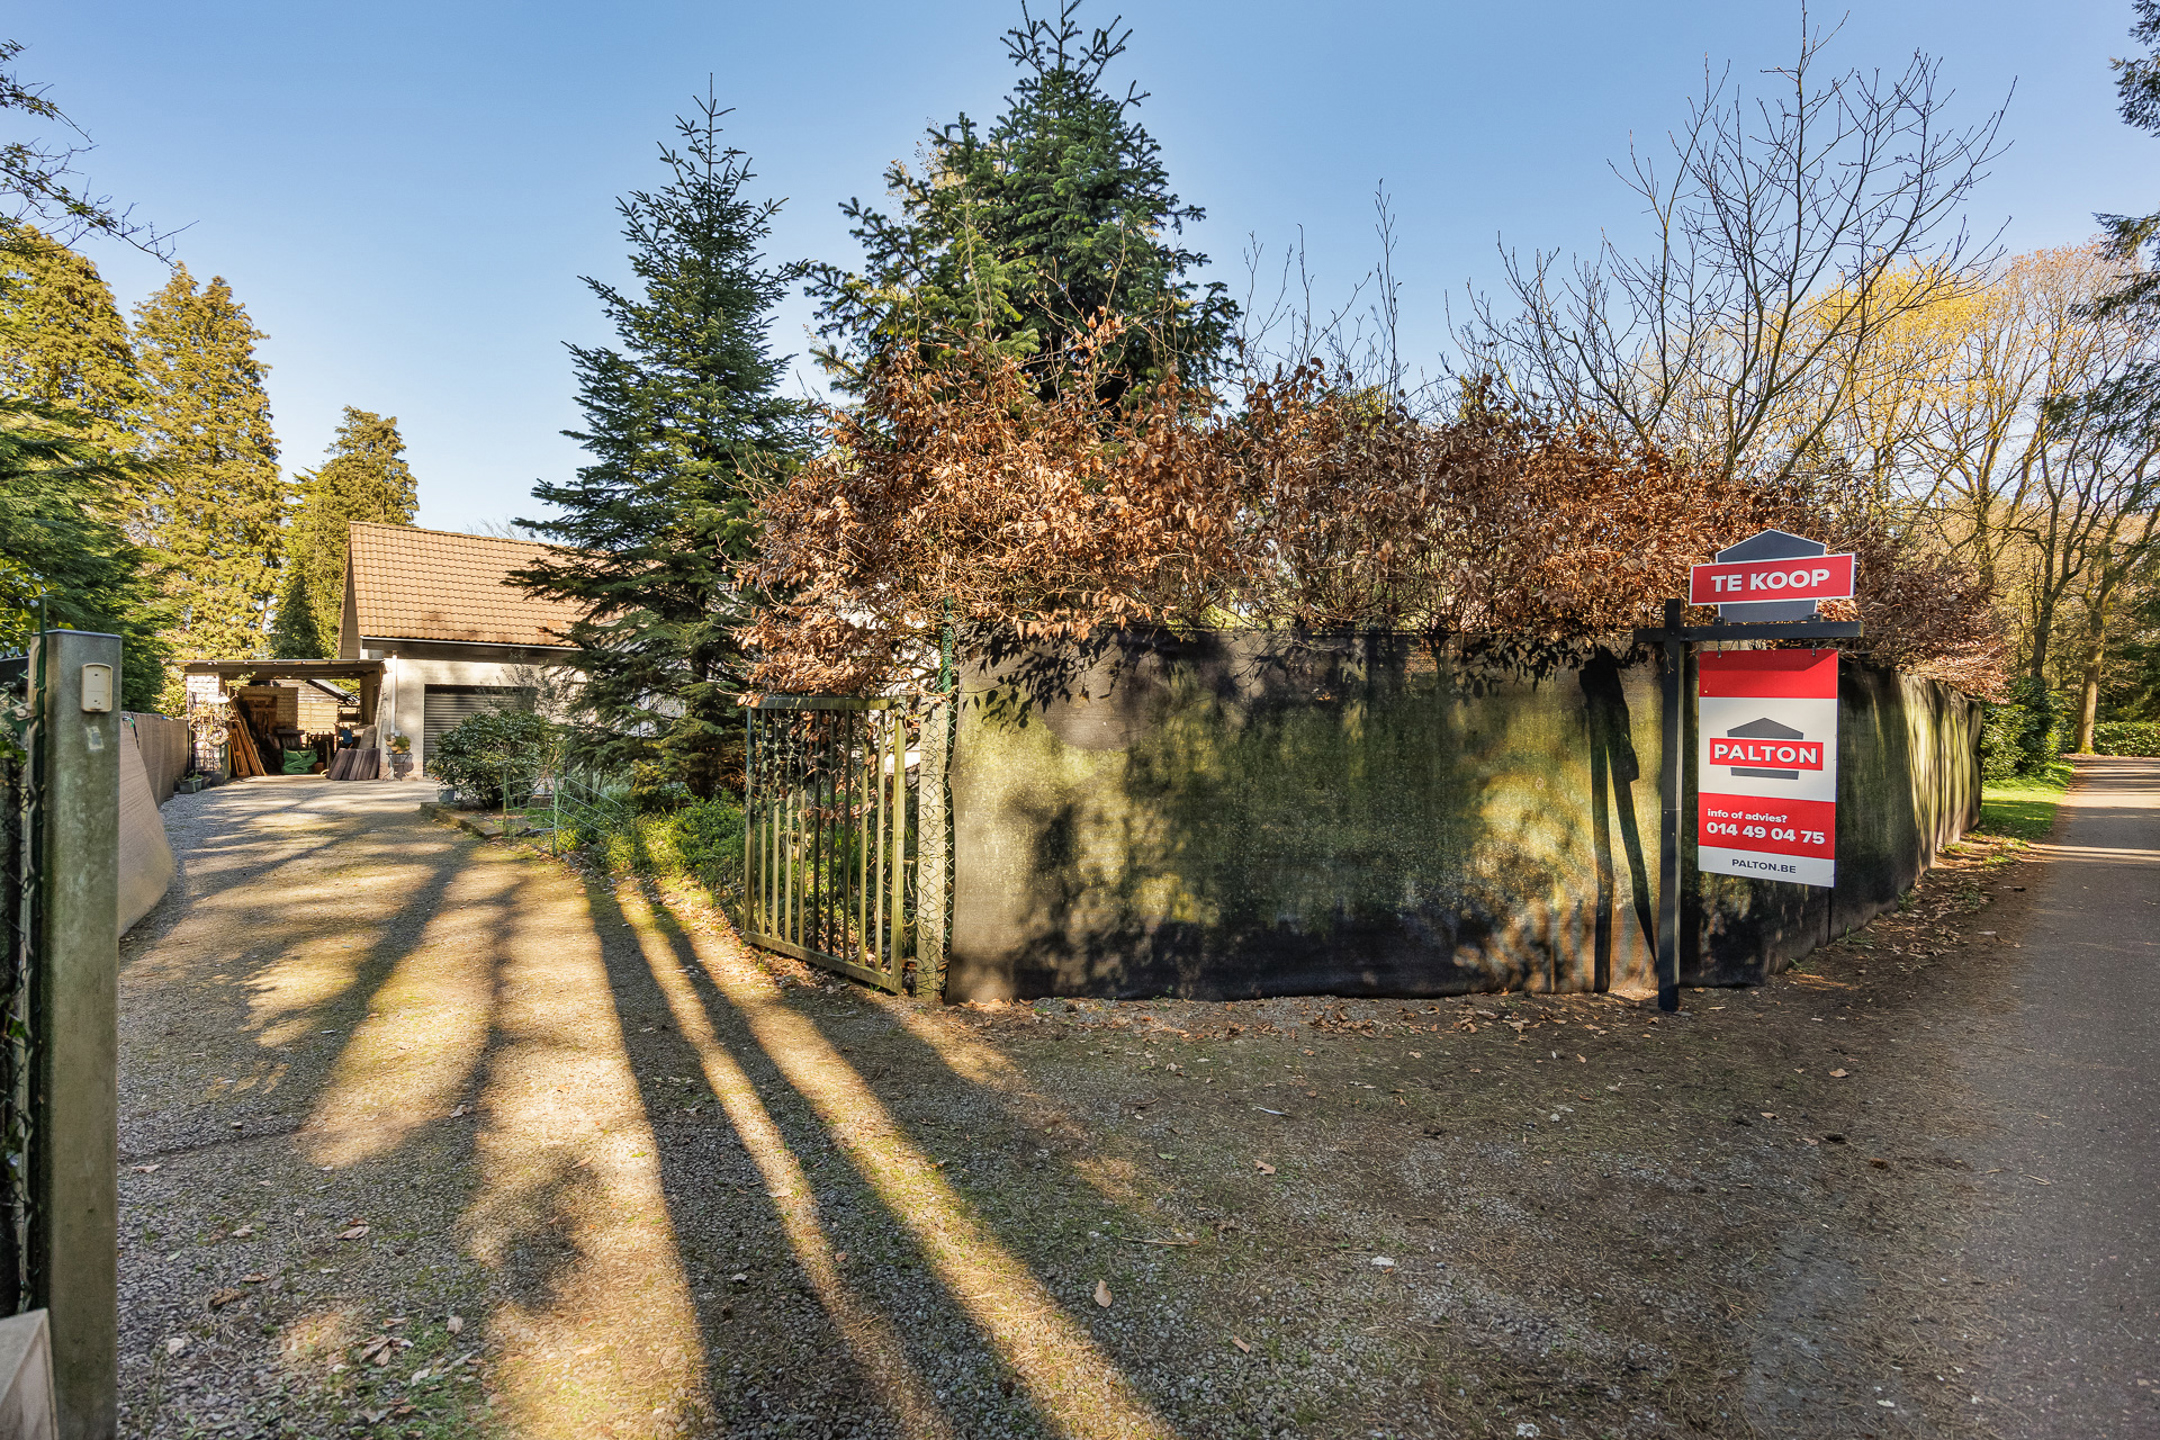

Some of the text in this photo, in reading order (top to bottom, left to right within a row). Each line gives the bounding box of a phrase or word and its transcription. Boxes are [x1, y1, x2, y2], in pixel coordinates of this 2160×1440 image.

[1711, 569, 1830, 593] TE KOOP
[1714, 744, 1817, 764] PALTON
[1707, 808, 1788, 823] info of advies?
[1706, 822, 1825, 845] 014 49 04 75
[1732, 859, 1797, 873] PALTON.BE
